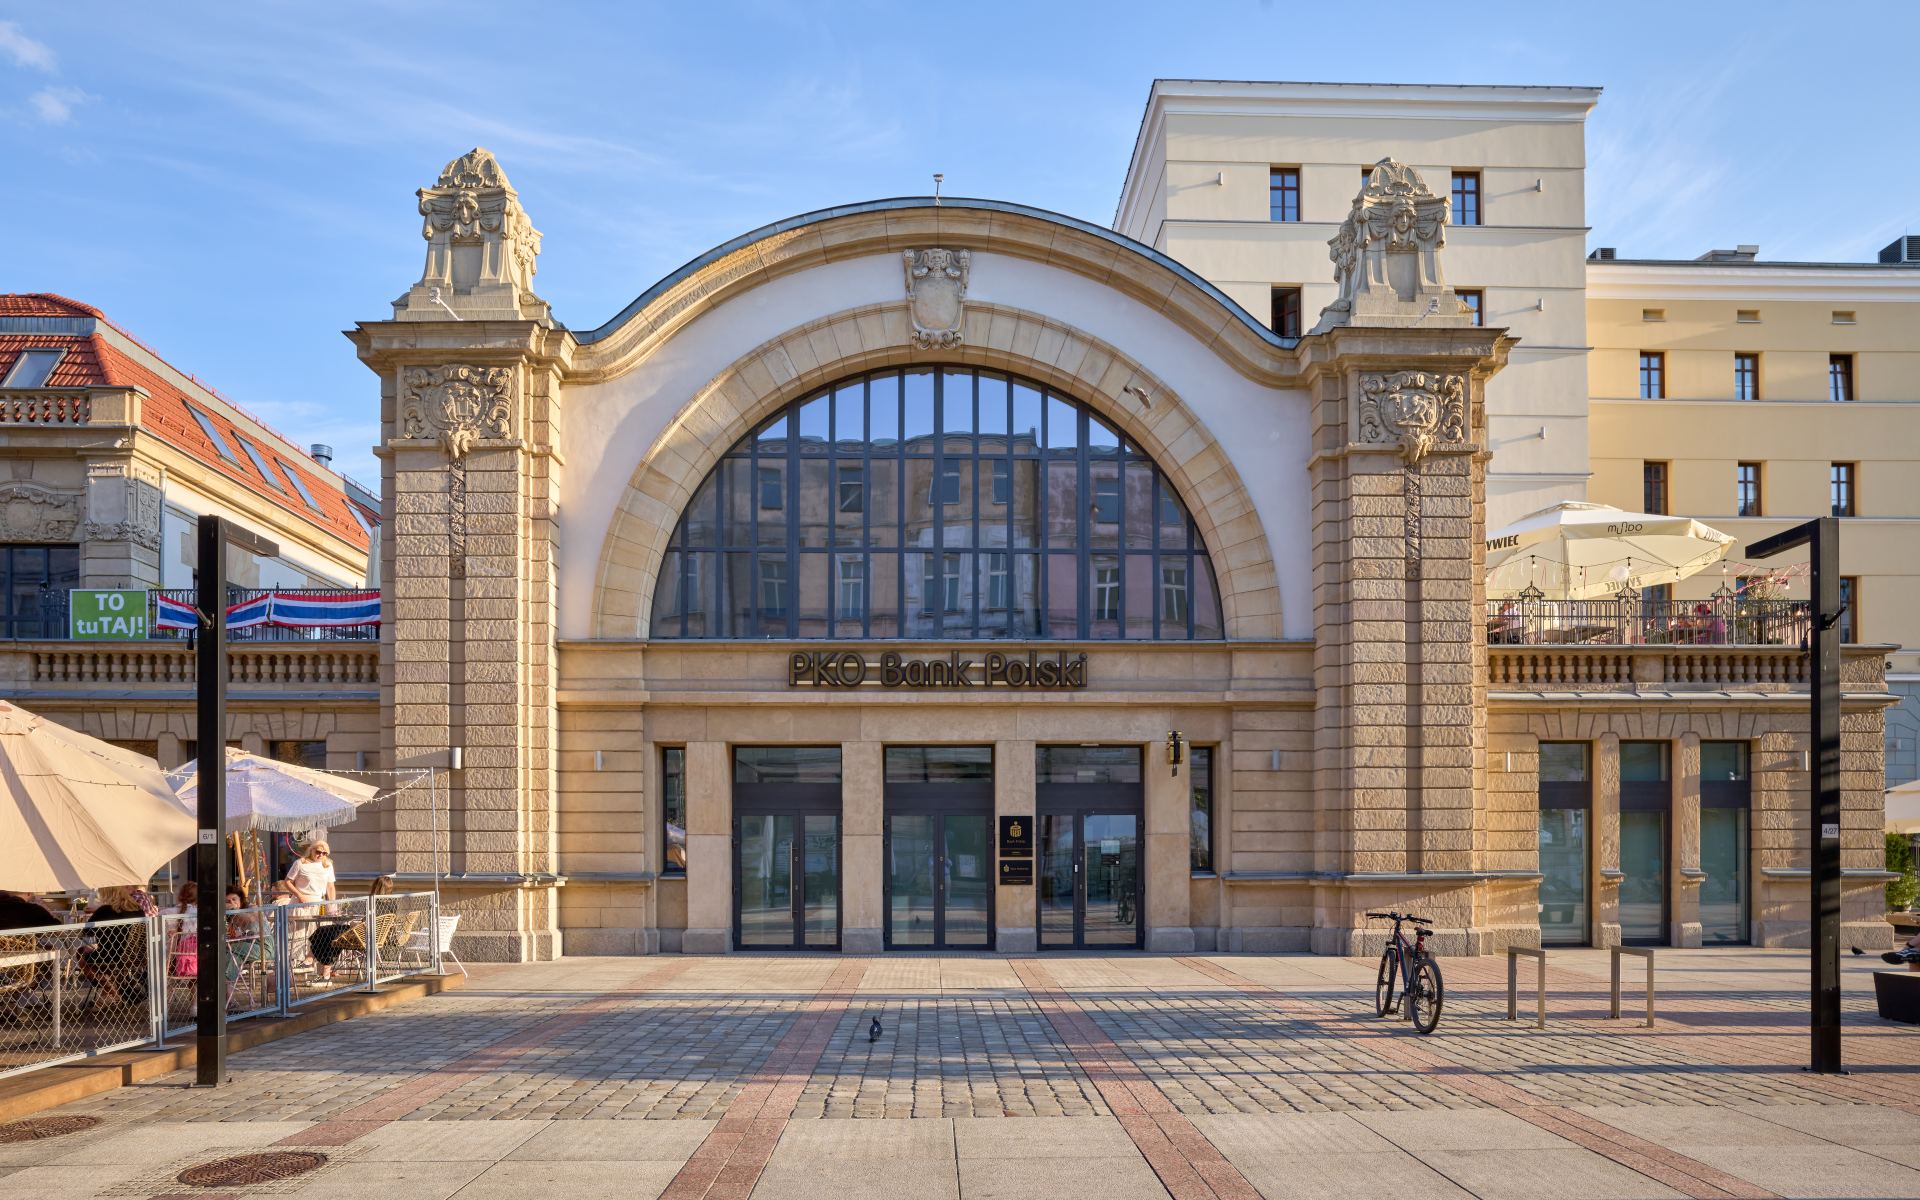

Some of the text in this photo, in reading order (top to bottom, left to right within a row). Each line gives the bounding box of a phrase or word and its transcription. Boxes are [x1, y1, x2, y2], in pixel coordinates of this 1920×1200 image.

[1486, 534, 1519, 551] YWIEC
[95, 593, 125, 611] TO
[76, 616, 143, 637] tuTAJ!
[788, 650, 1088, 687] PKO Bank Polski
[1823, 827, 1837, 835] 4/27
